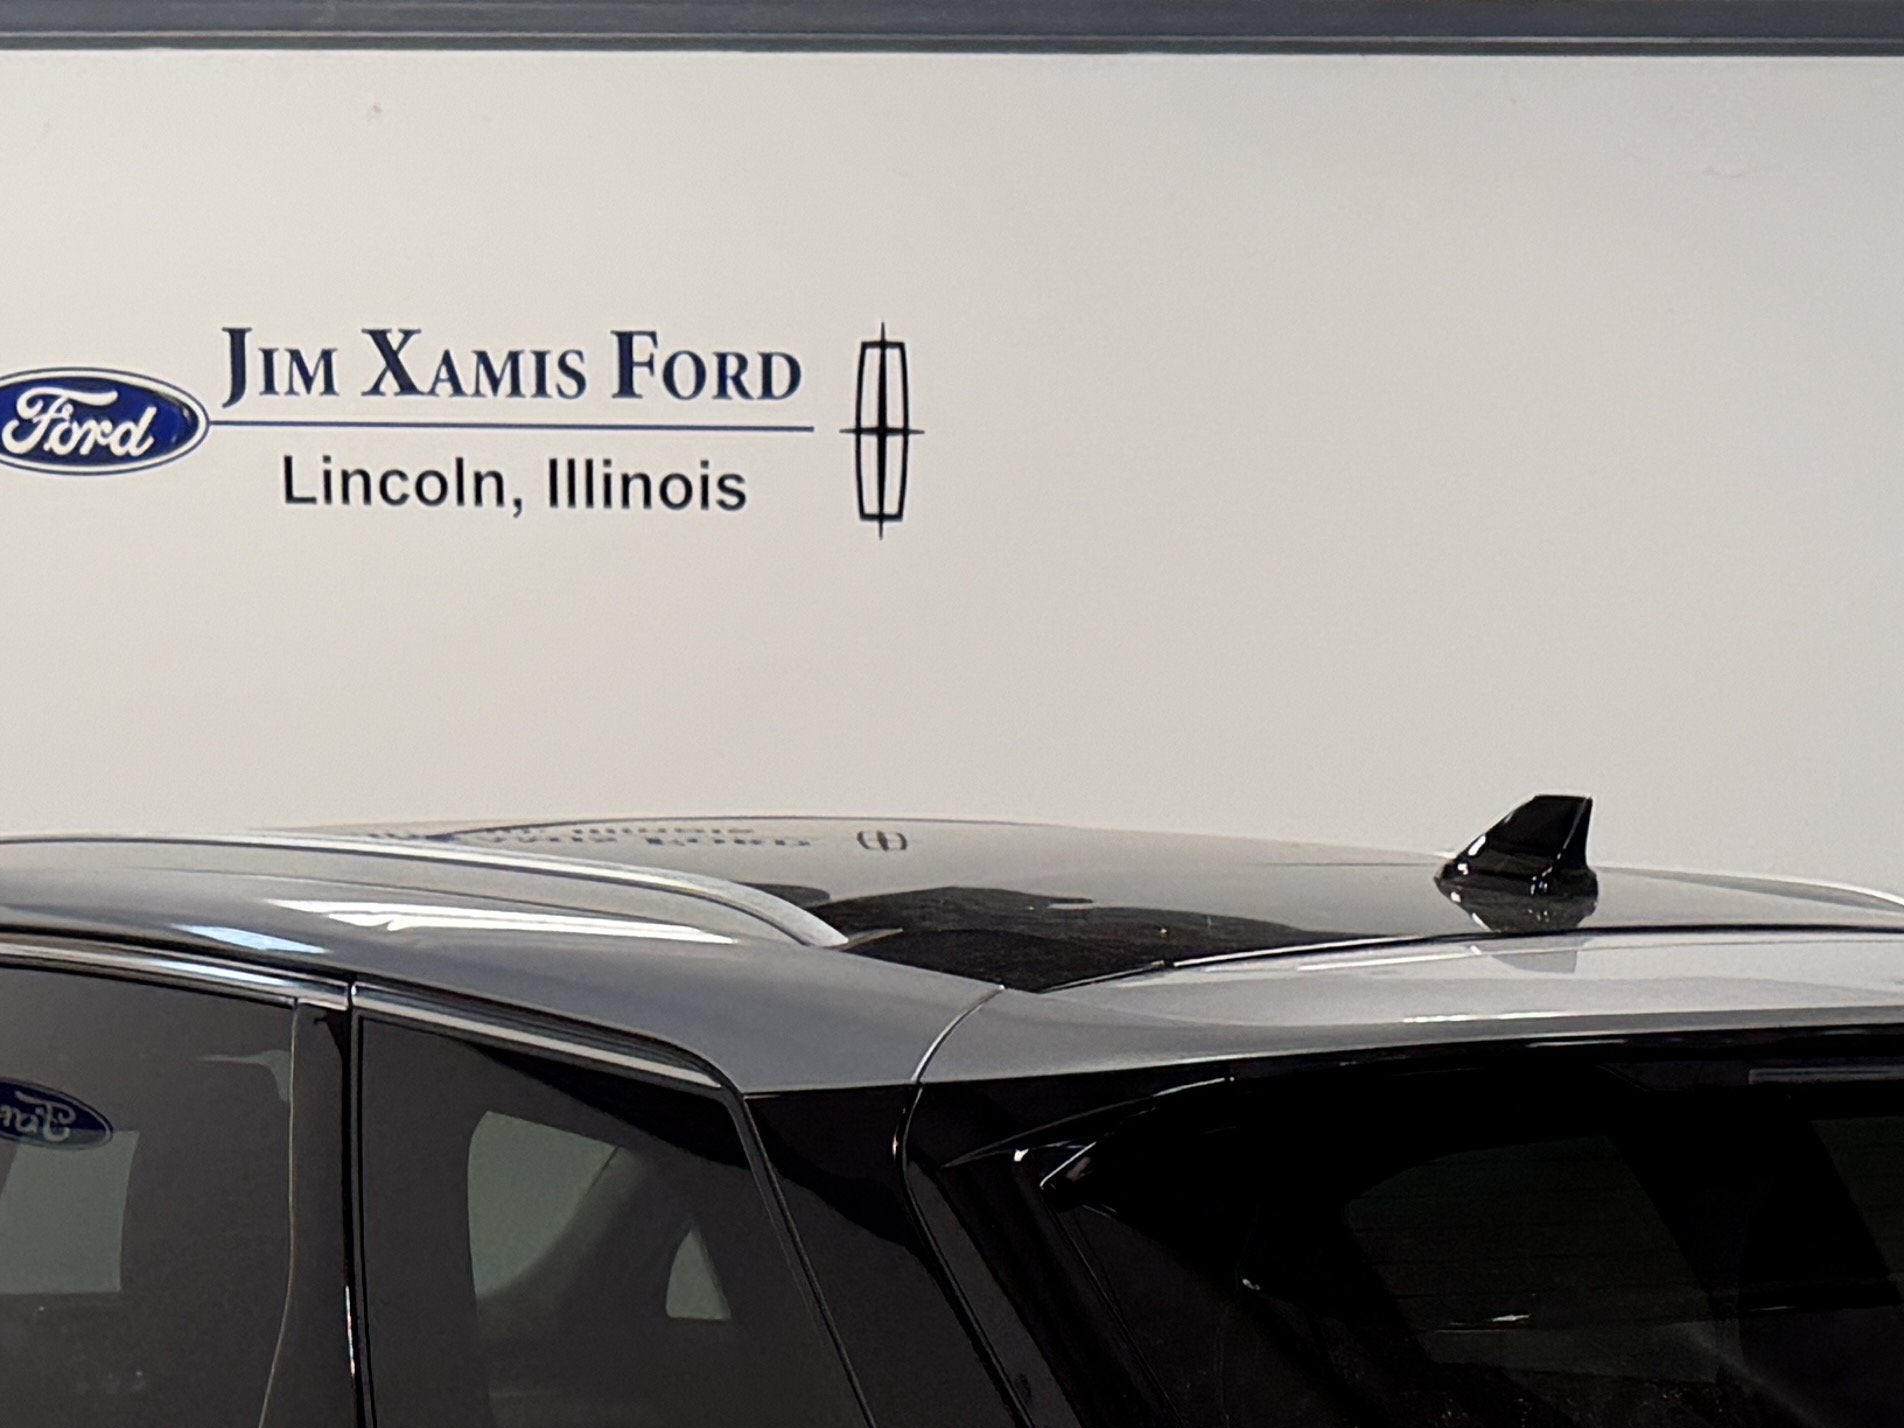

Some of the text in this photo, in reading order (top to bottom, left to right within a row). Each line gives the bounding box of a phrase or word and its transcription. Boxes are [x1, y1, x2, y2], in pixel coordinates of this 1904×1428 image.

[222, 327, 802, 409] JIM XAMIS FORD
[1, 386, 157, 457] Ford
[283, 455, 747, 518] Lincoln, Illinois
